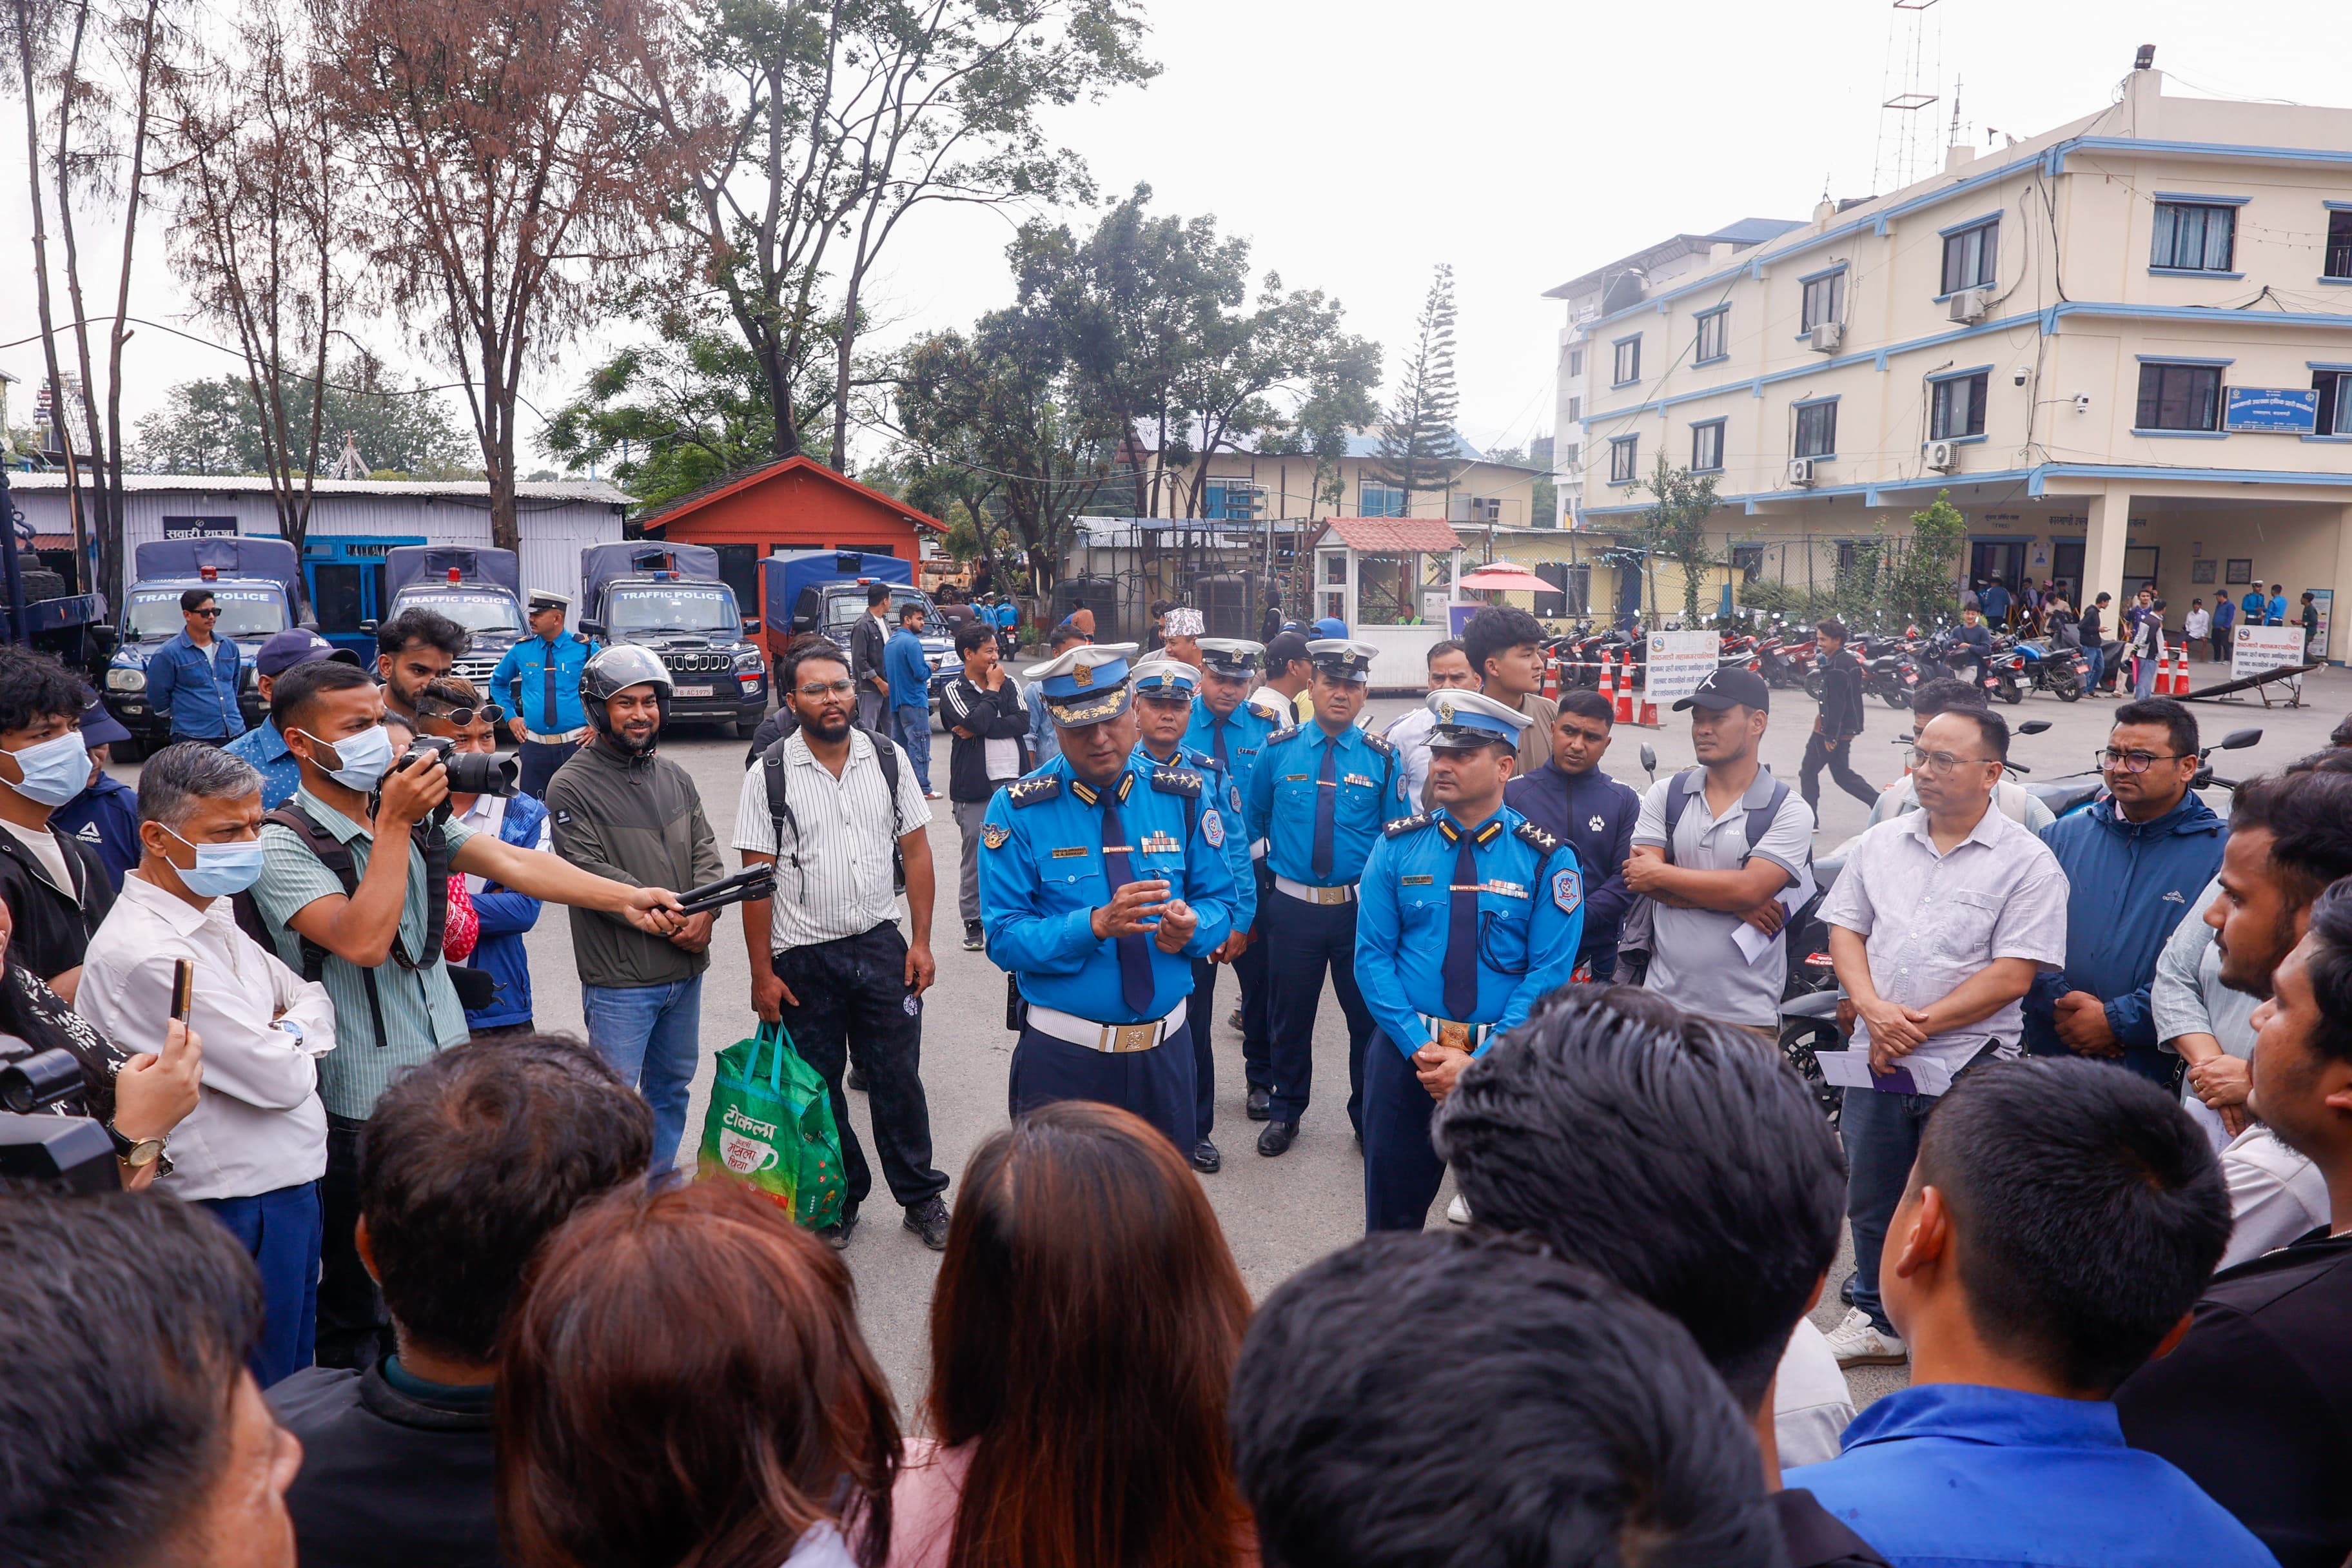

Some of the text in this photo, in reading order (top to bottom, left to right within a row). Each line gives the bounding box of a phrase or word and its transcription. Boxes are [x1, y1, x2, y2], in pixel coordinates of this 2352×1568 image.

[166, 527, 201, 538] सवारी
[136, 593, 269, 603] TRAFF POLICE
[463, 597, 511, 605] POLICE
[621, 591, 724, 601] TRAFFIC POLICE
[723, 1104, 778, 1141] टोकला
[728, 1155, 748, 1171] चिया
